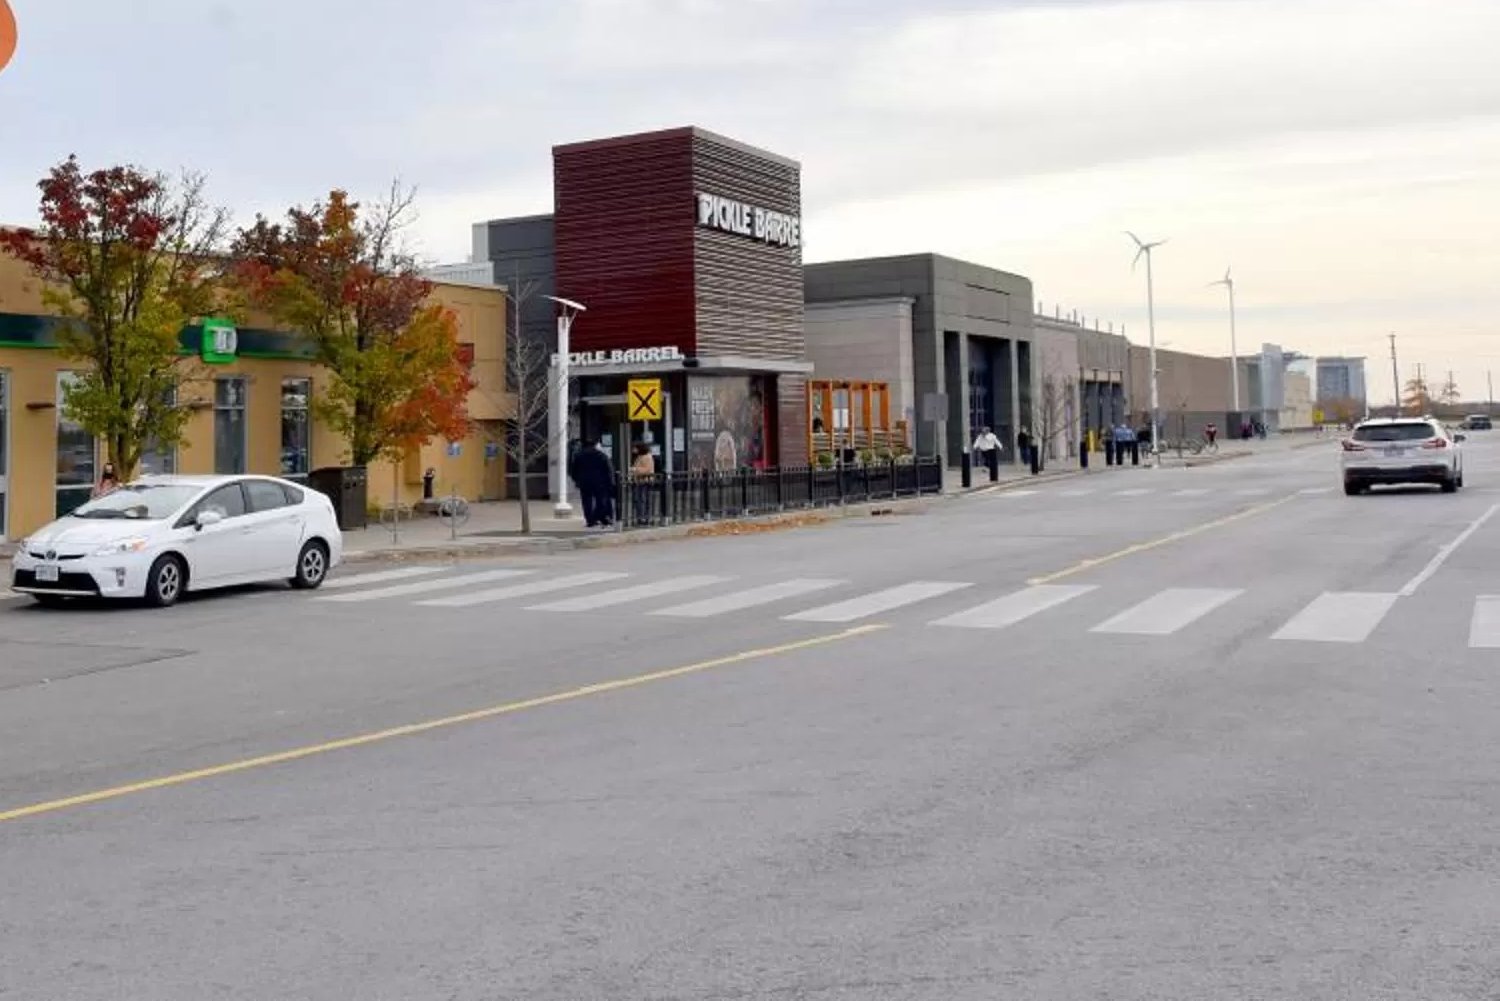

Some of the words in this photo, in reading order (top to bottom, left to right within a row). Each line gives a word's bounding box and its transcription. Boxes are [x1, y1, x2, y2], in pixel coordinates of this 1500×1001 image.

[699, 193, 751, 235] PICKLE
[754, 207, 803, 248] BARRE
[550, 349, 606, 367] PCKLE
[611, 345, 685, 363] BARREL
